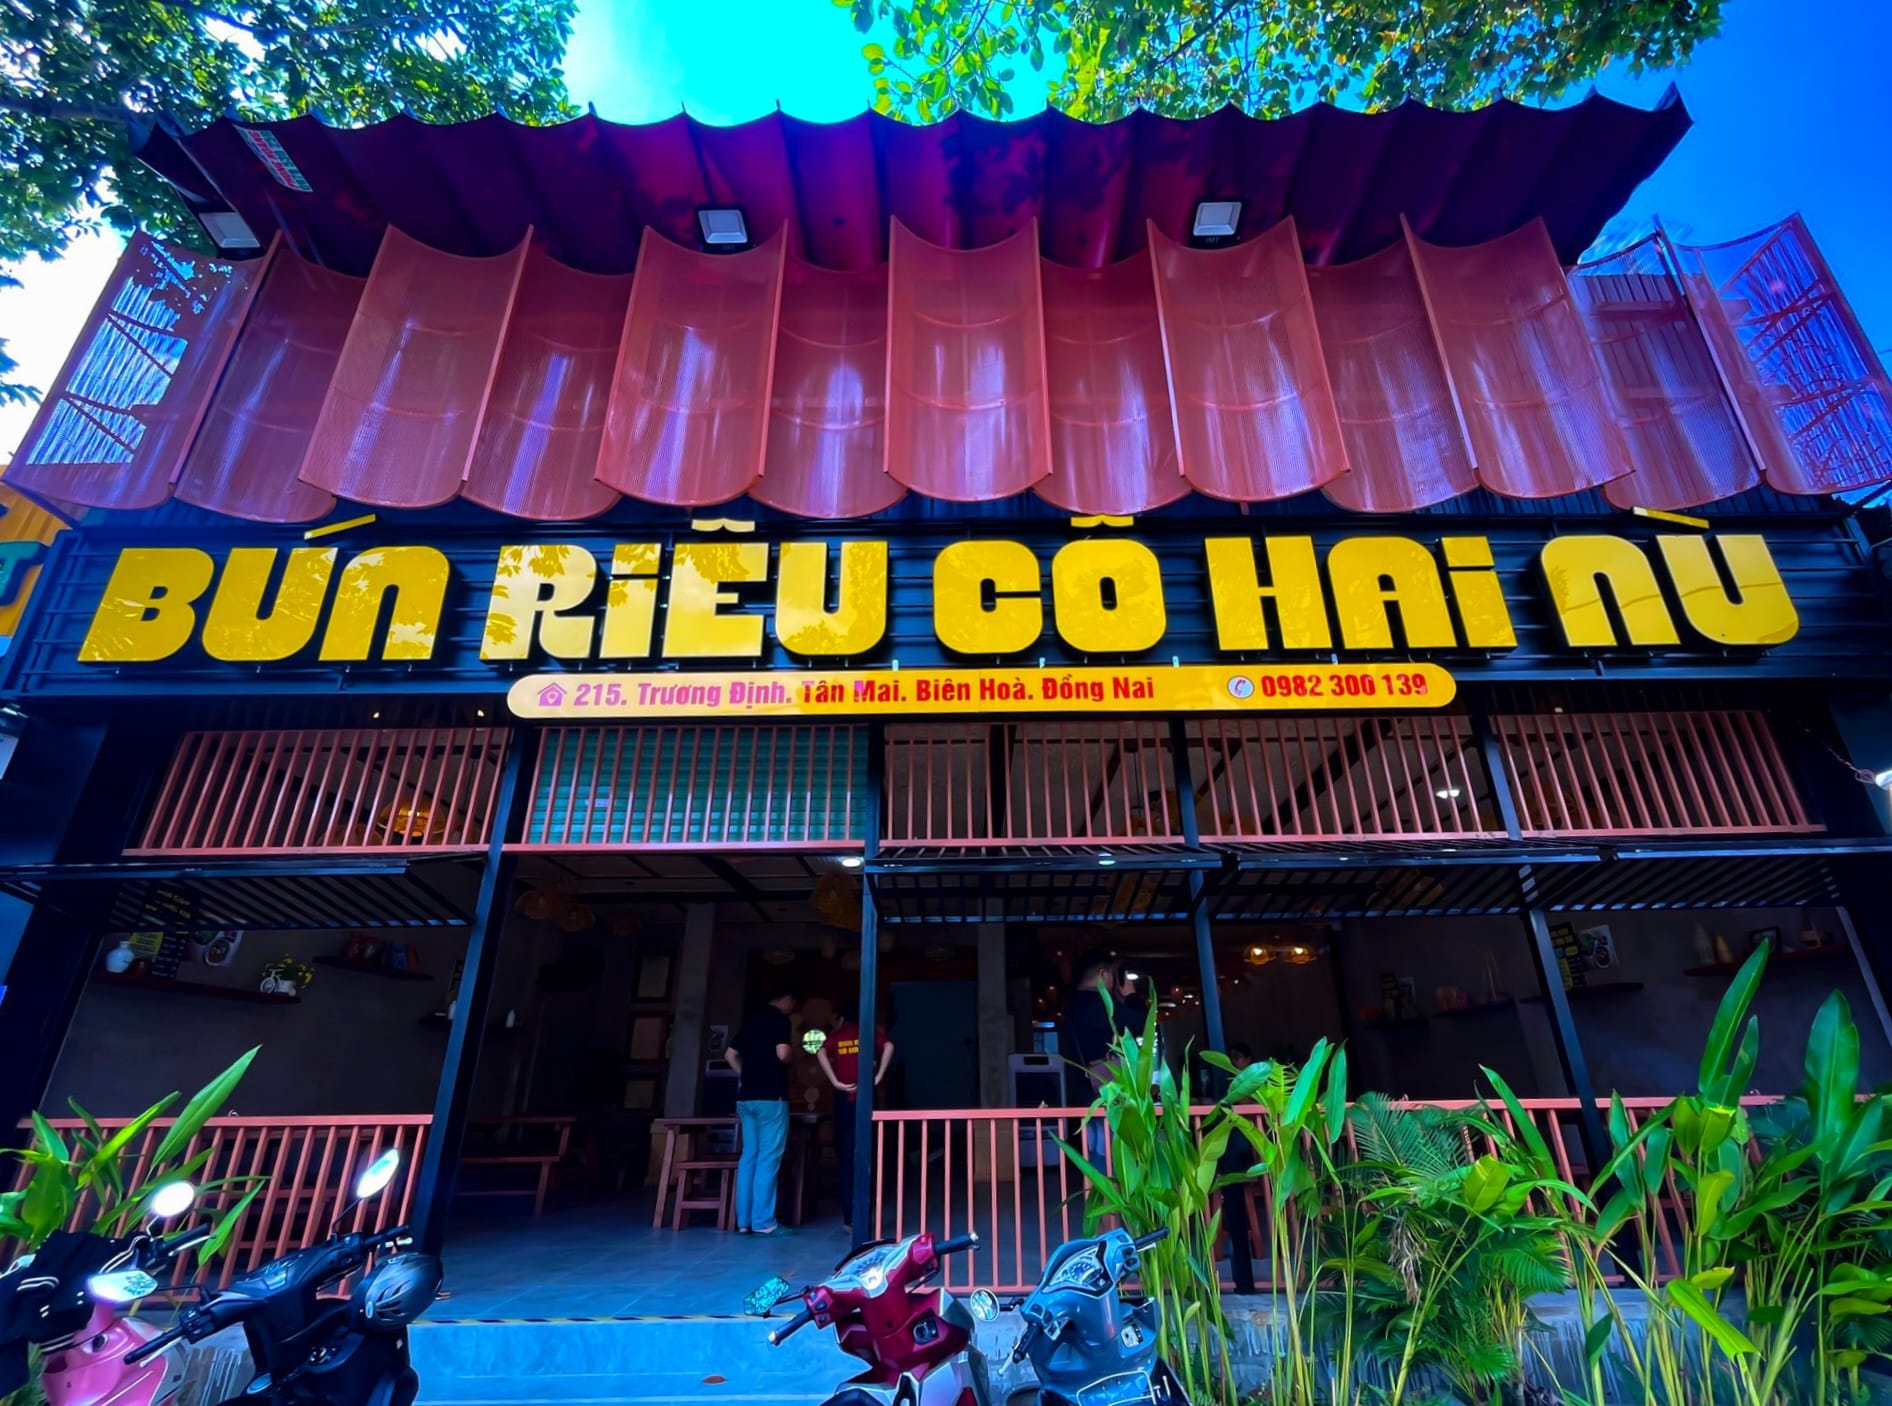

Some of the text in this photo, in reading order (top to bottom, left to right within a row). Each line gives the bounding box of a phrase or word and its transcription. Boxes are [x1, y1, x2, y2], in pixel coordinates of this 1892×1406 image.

[574, 673, 1155, 709] 215. Trương Định. Tân Mai. Biên Hoà. Đồng Nai
[1261, 672, 1429, 698] 0982 300 139
